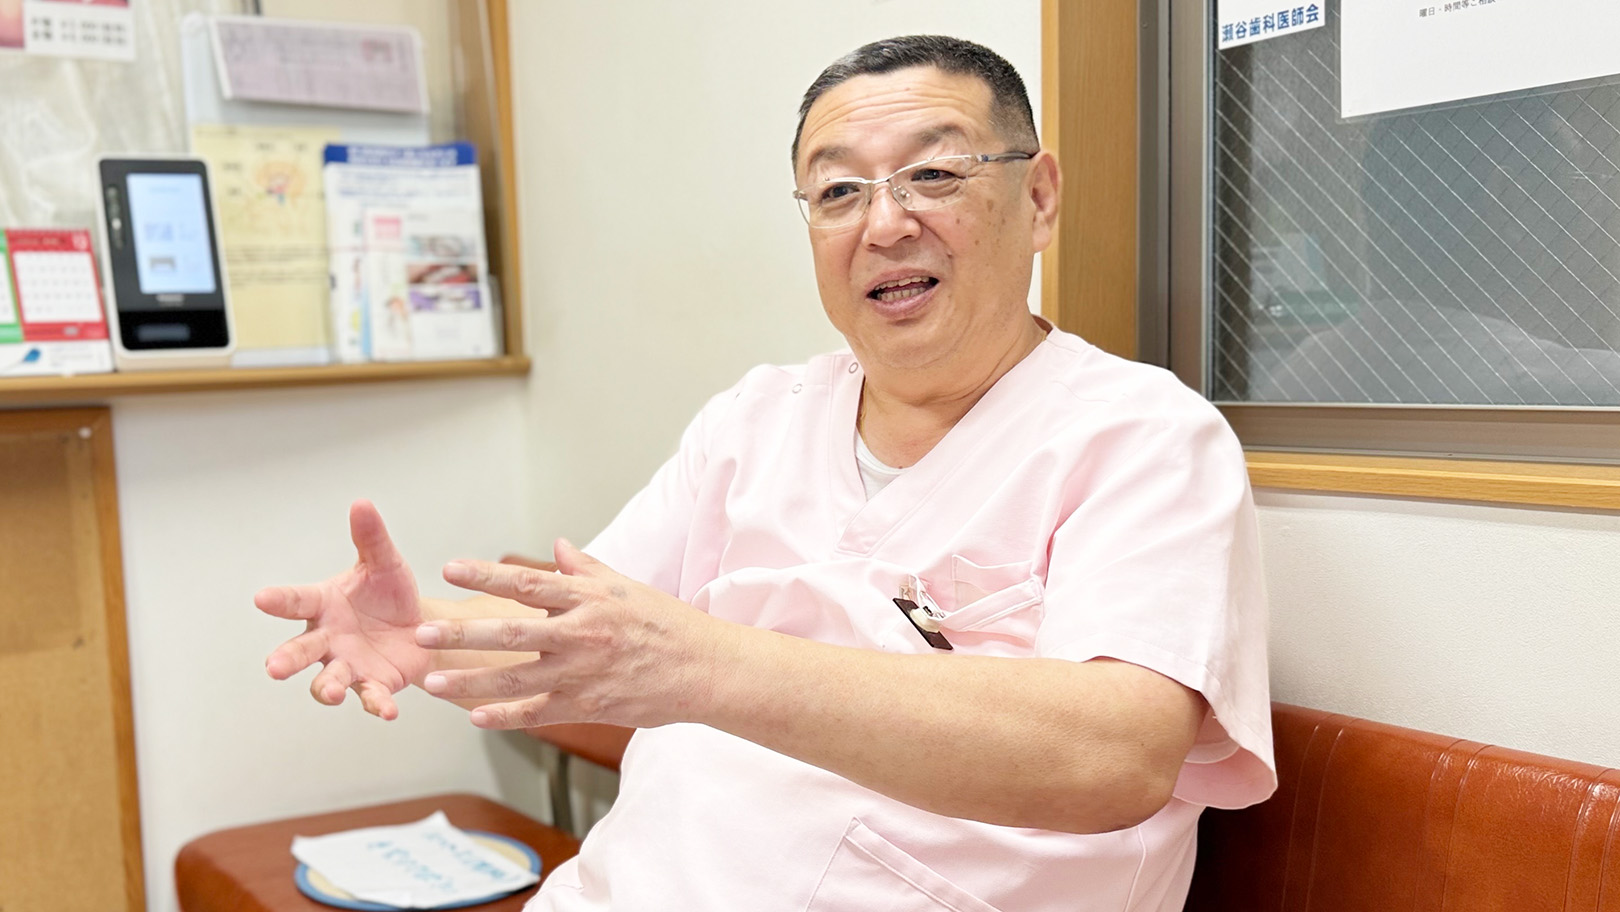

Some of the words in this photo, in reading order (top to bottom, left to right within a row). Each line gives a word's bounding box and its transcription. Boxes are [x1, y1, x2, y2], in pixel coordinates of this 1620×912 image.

[1221, 3, 1319, 42] 瀬谷歯科医師会
